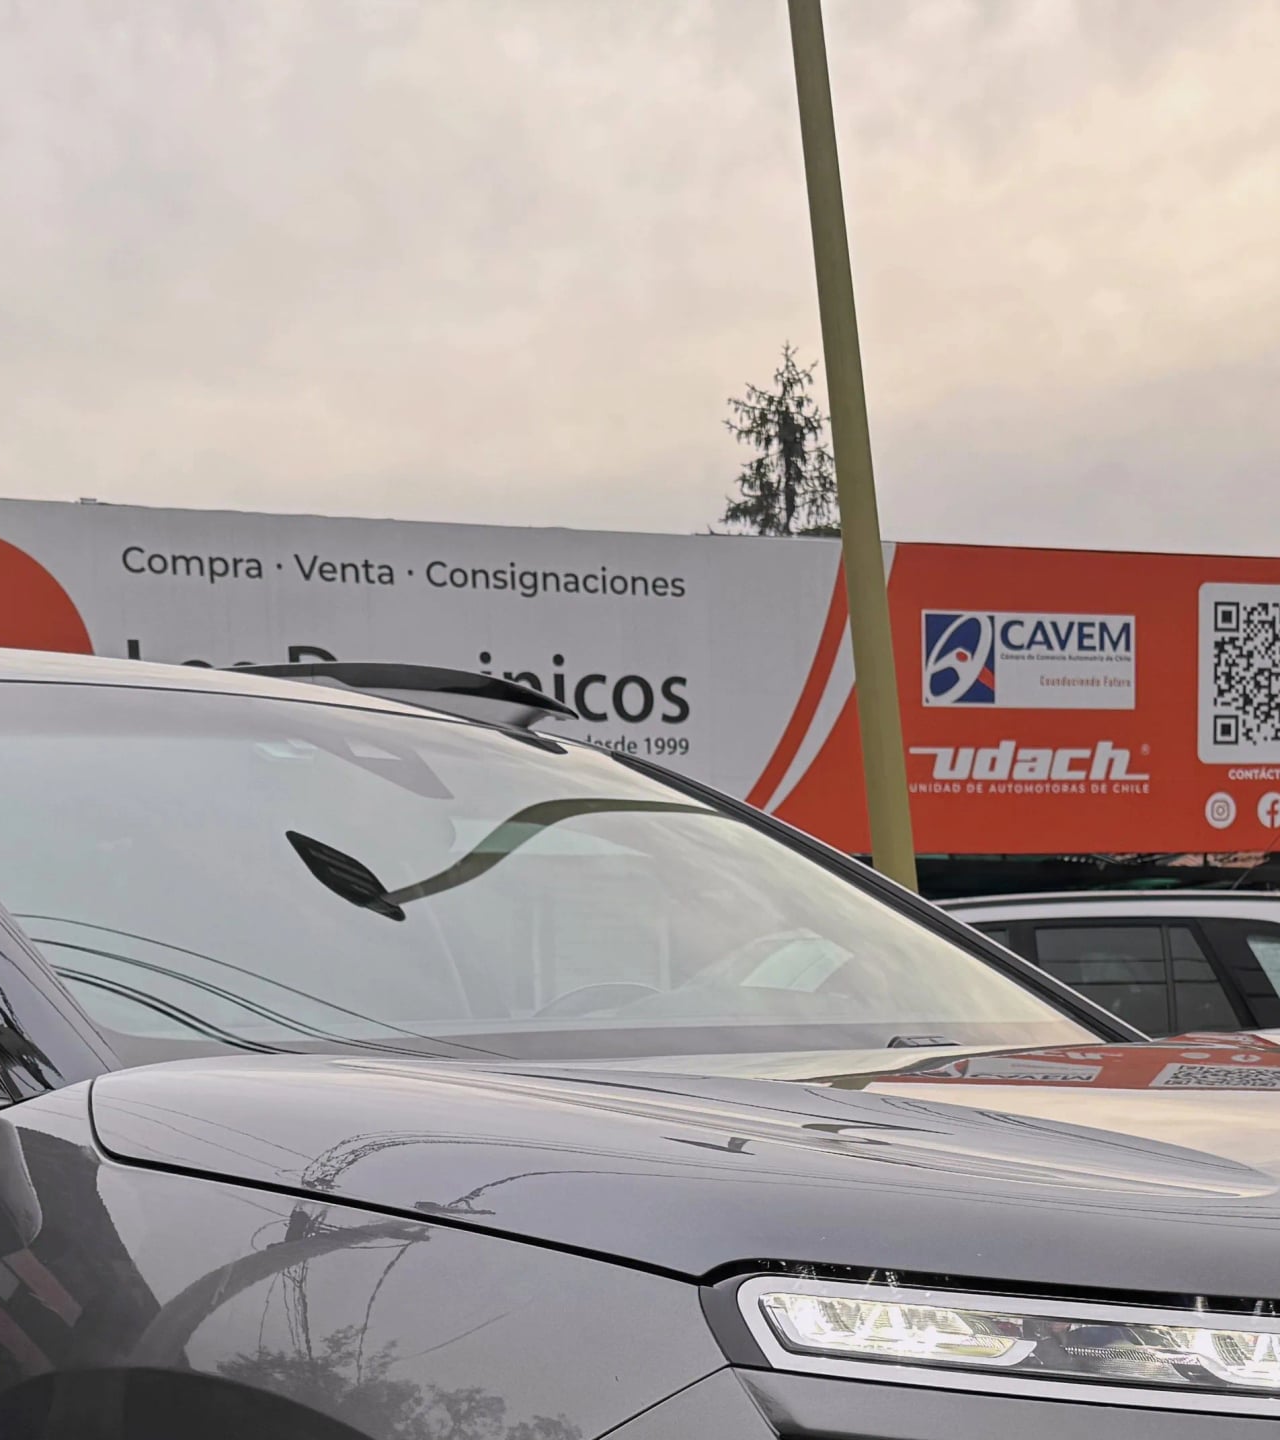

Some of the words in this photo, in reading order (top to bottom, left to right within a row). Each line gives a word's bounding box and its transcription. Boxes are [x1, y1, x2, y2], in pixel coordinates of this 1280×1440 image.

[122, 546, 263, 585] Compra
[293, 553, 395, 586] Venta
[425, 560, 687, 598] Consignaciones
[1000, 619, 1131, 653] CAVEM
[644, 737, 690, 755] 1999
[909, 740, 1150, 781] udach
[908, 783, 962, 794] UNIDAD
[966, 783, 983, 794] DE
[988, 783, 1086, 794] AUTOMOTORAS
[1090, 783, 1108, 794] DE
[1112, 783, 1150, 794] CHILE
